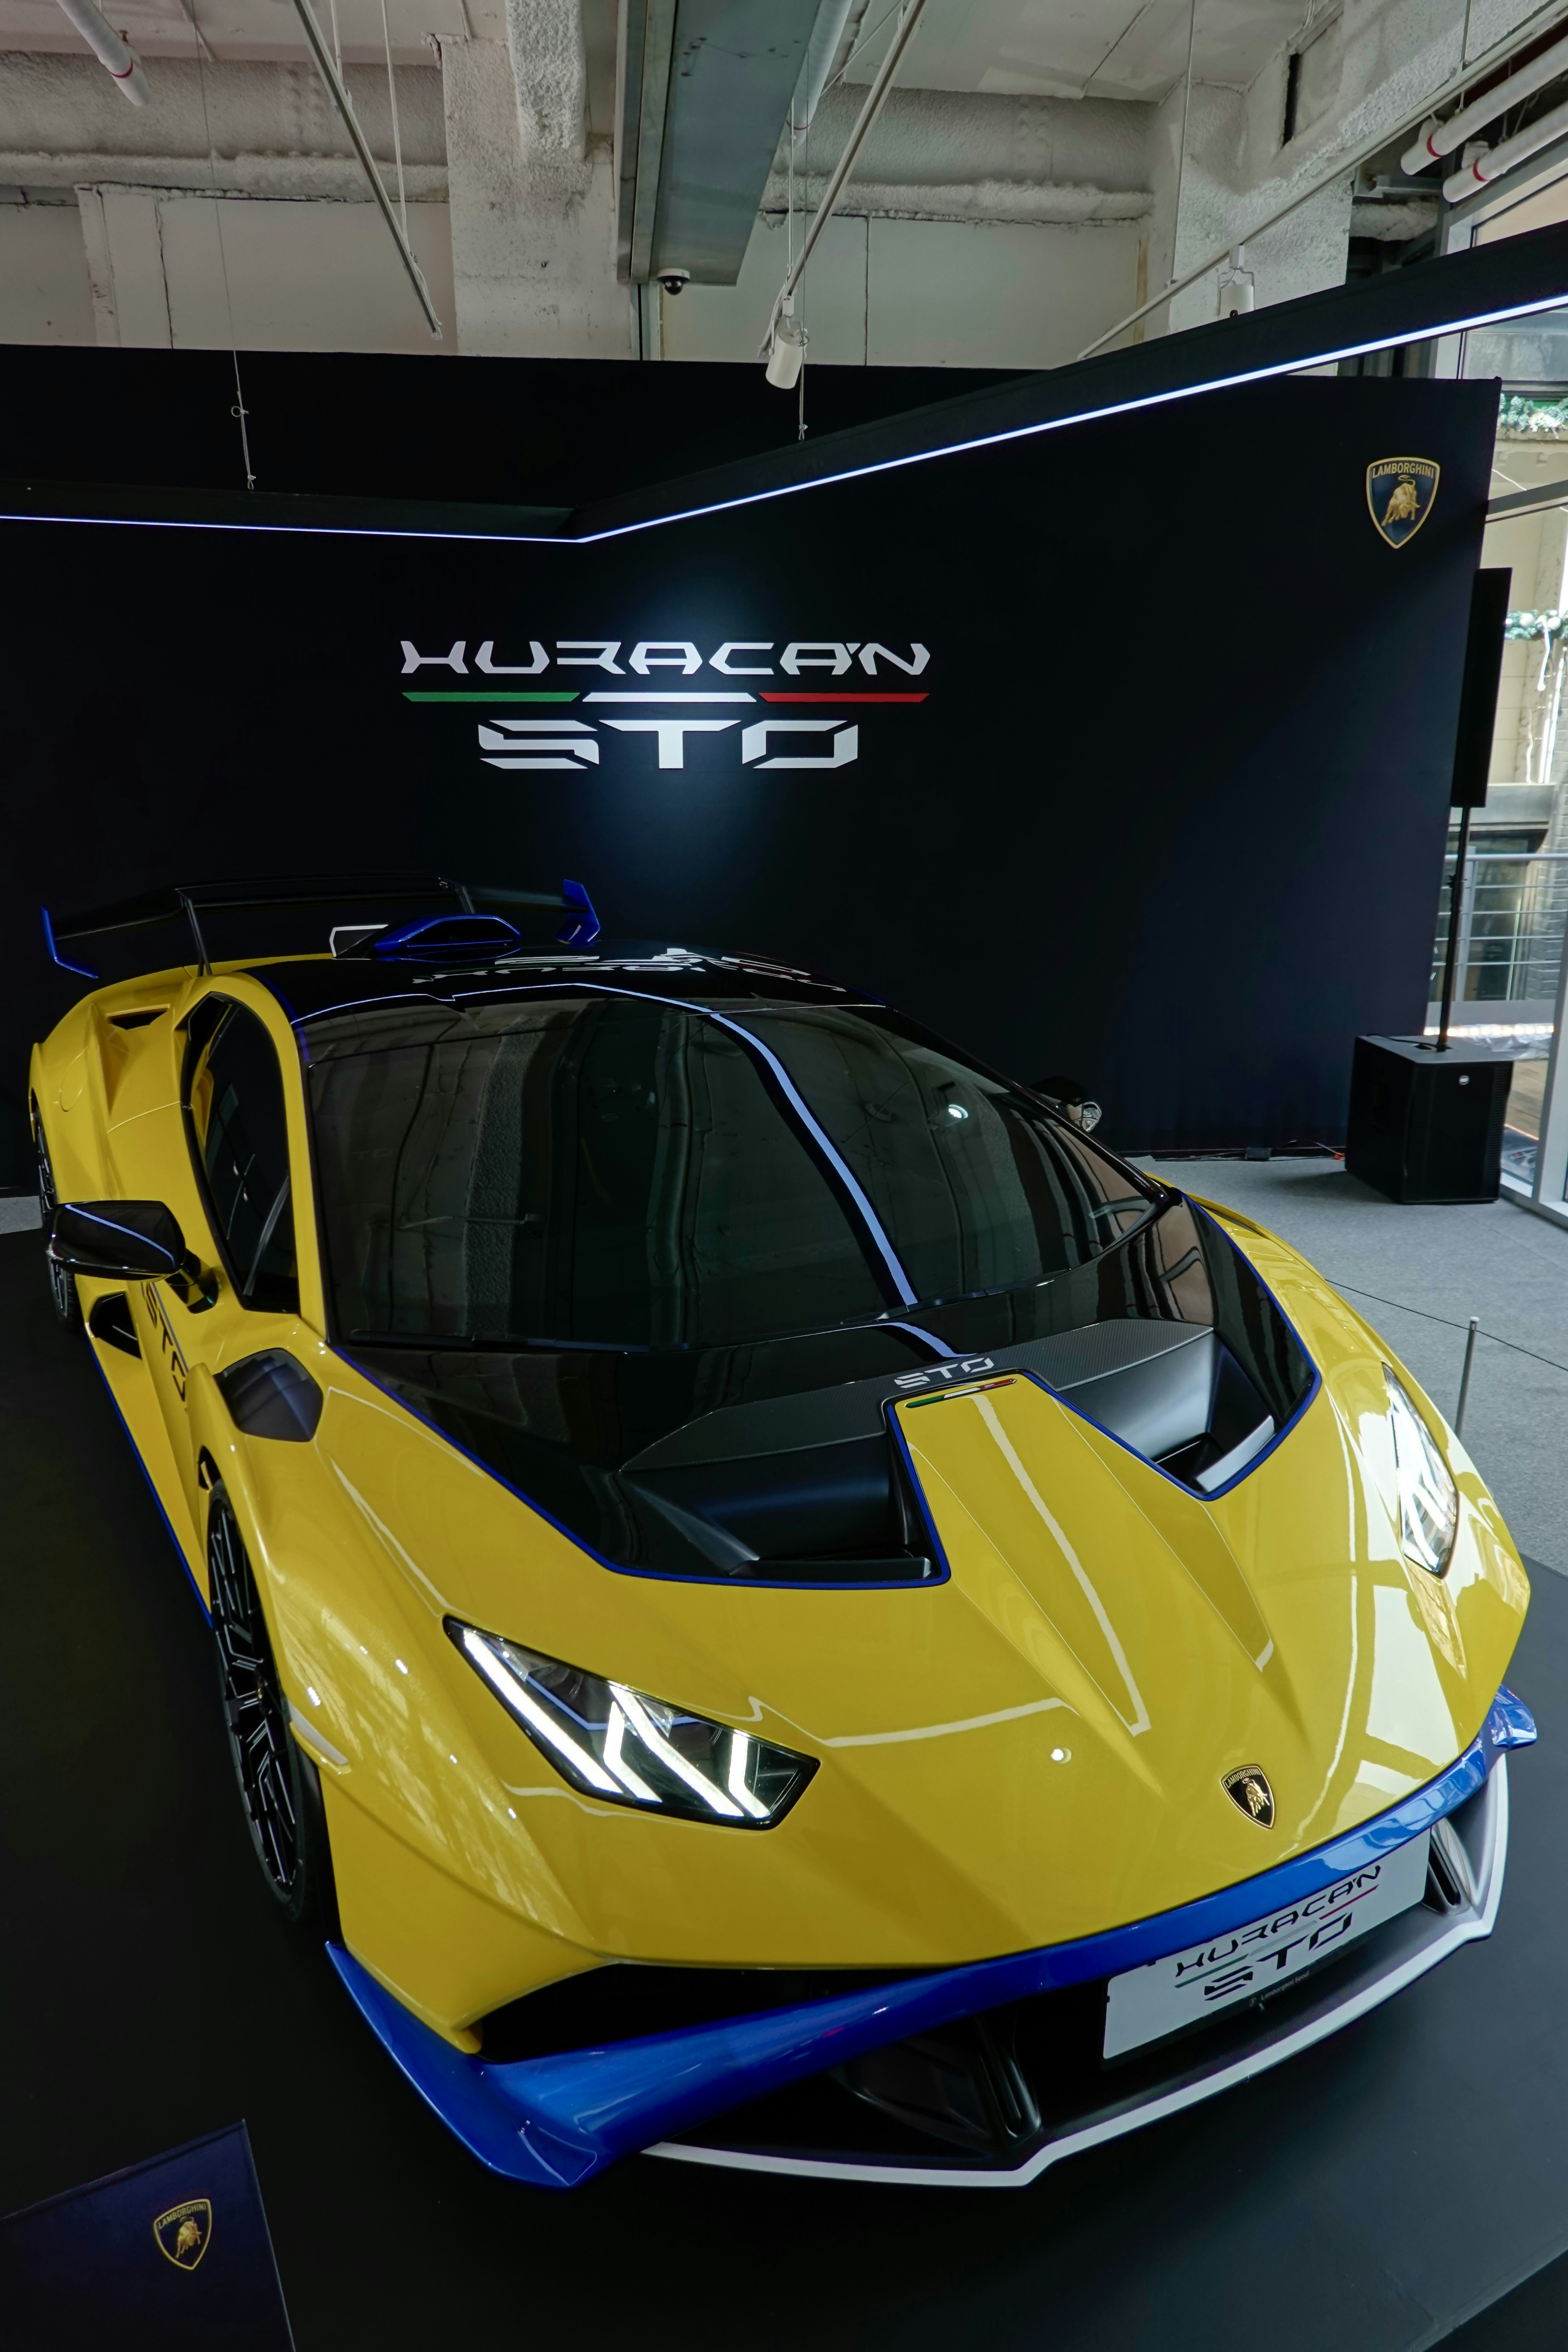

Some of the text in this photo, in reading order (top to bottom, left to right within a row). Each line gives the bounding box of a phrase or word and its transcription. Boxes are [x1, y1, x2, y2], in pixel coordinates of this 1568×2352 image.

[1372, 462, 1434, 478] LAMBORGHINI
[478, 720, 858, 769] STO
[894, 1357, 994, 1388] STO
[1225, 1768, 1261, 1788] LAMBORGHINI
[1204, 1912, 1353, 2001] STO
[158, 2202, 207, 2230] LAMBORGHINI
